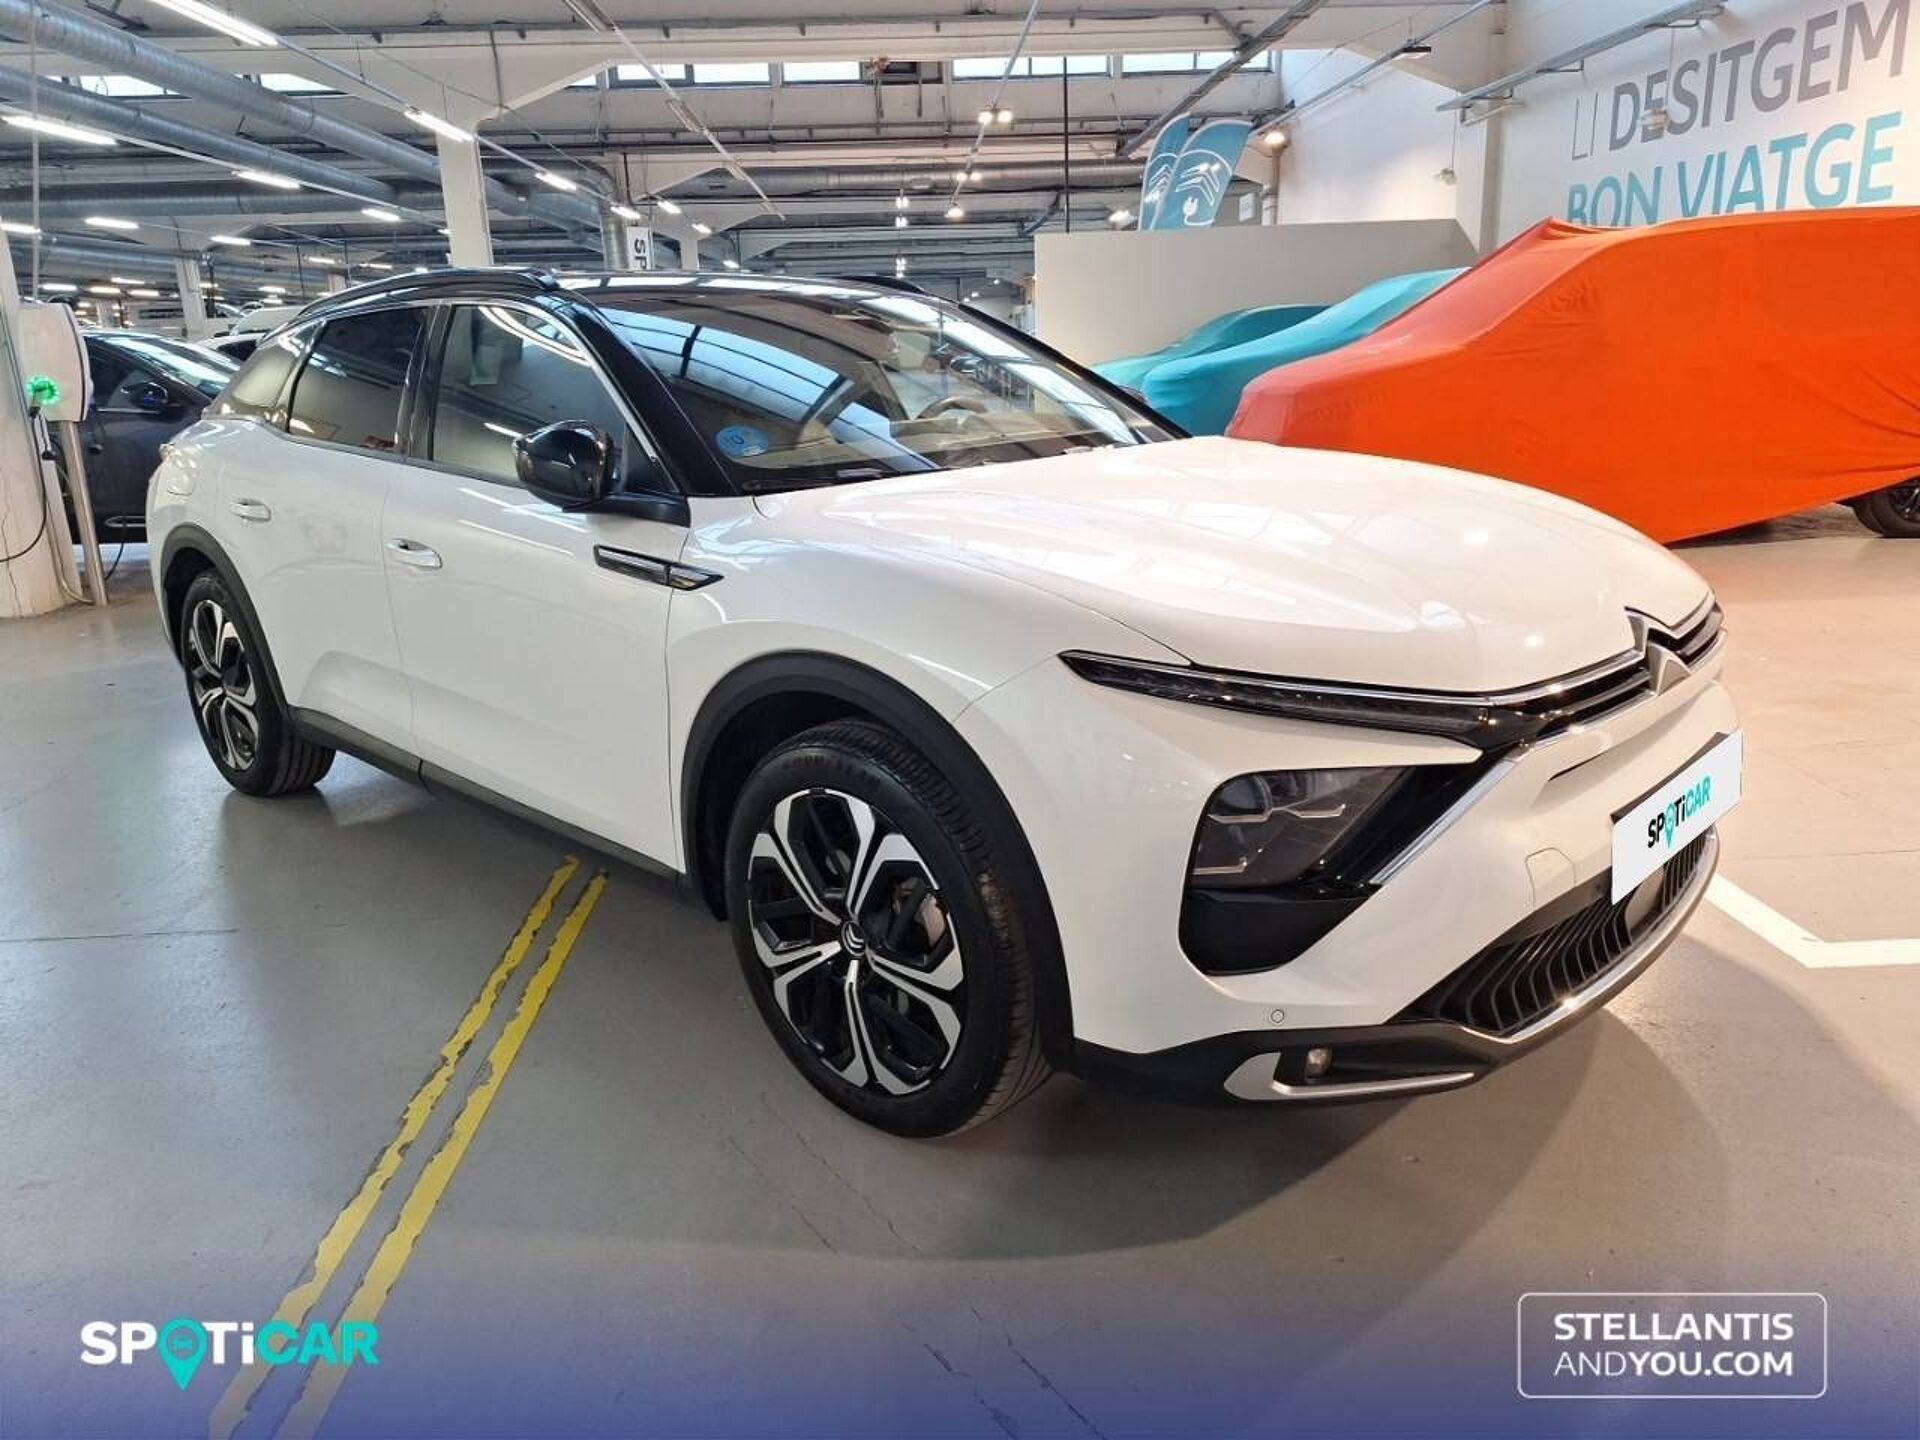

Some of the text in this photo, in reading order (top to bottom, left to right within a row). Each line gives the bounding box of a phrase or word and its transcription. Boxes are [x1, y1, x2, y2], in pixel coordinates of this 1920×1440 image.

[1609, 0, 1910, 151] DESITGEM
[1566, 111, 1903, 228] BON VIATGE
